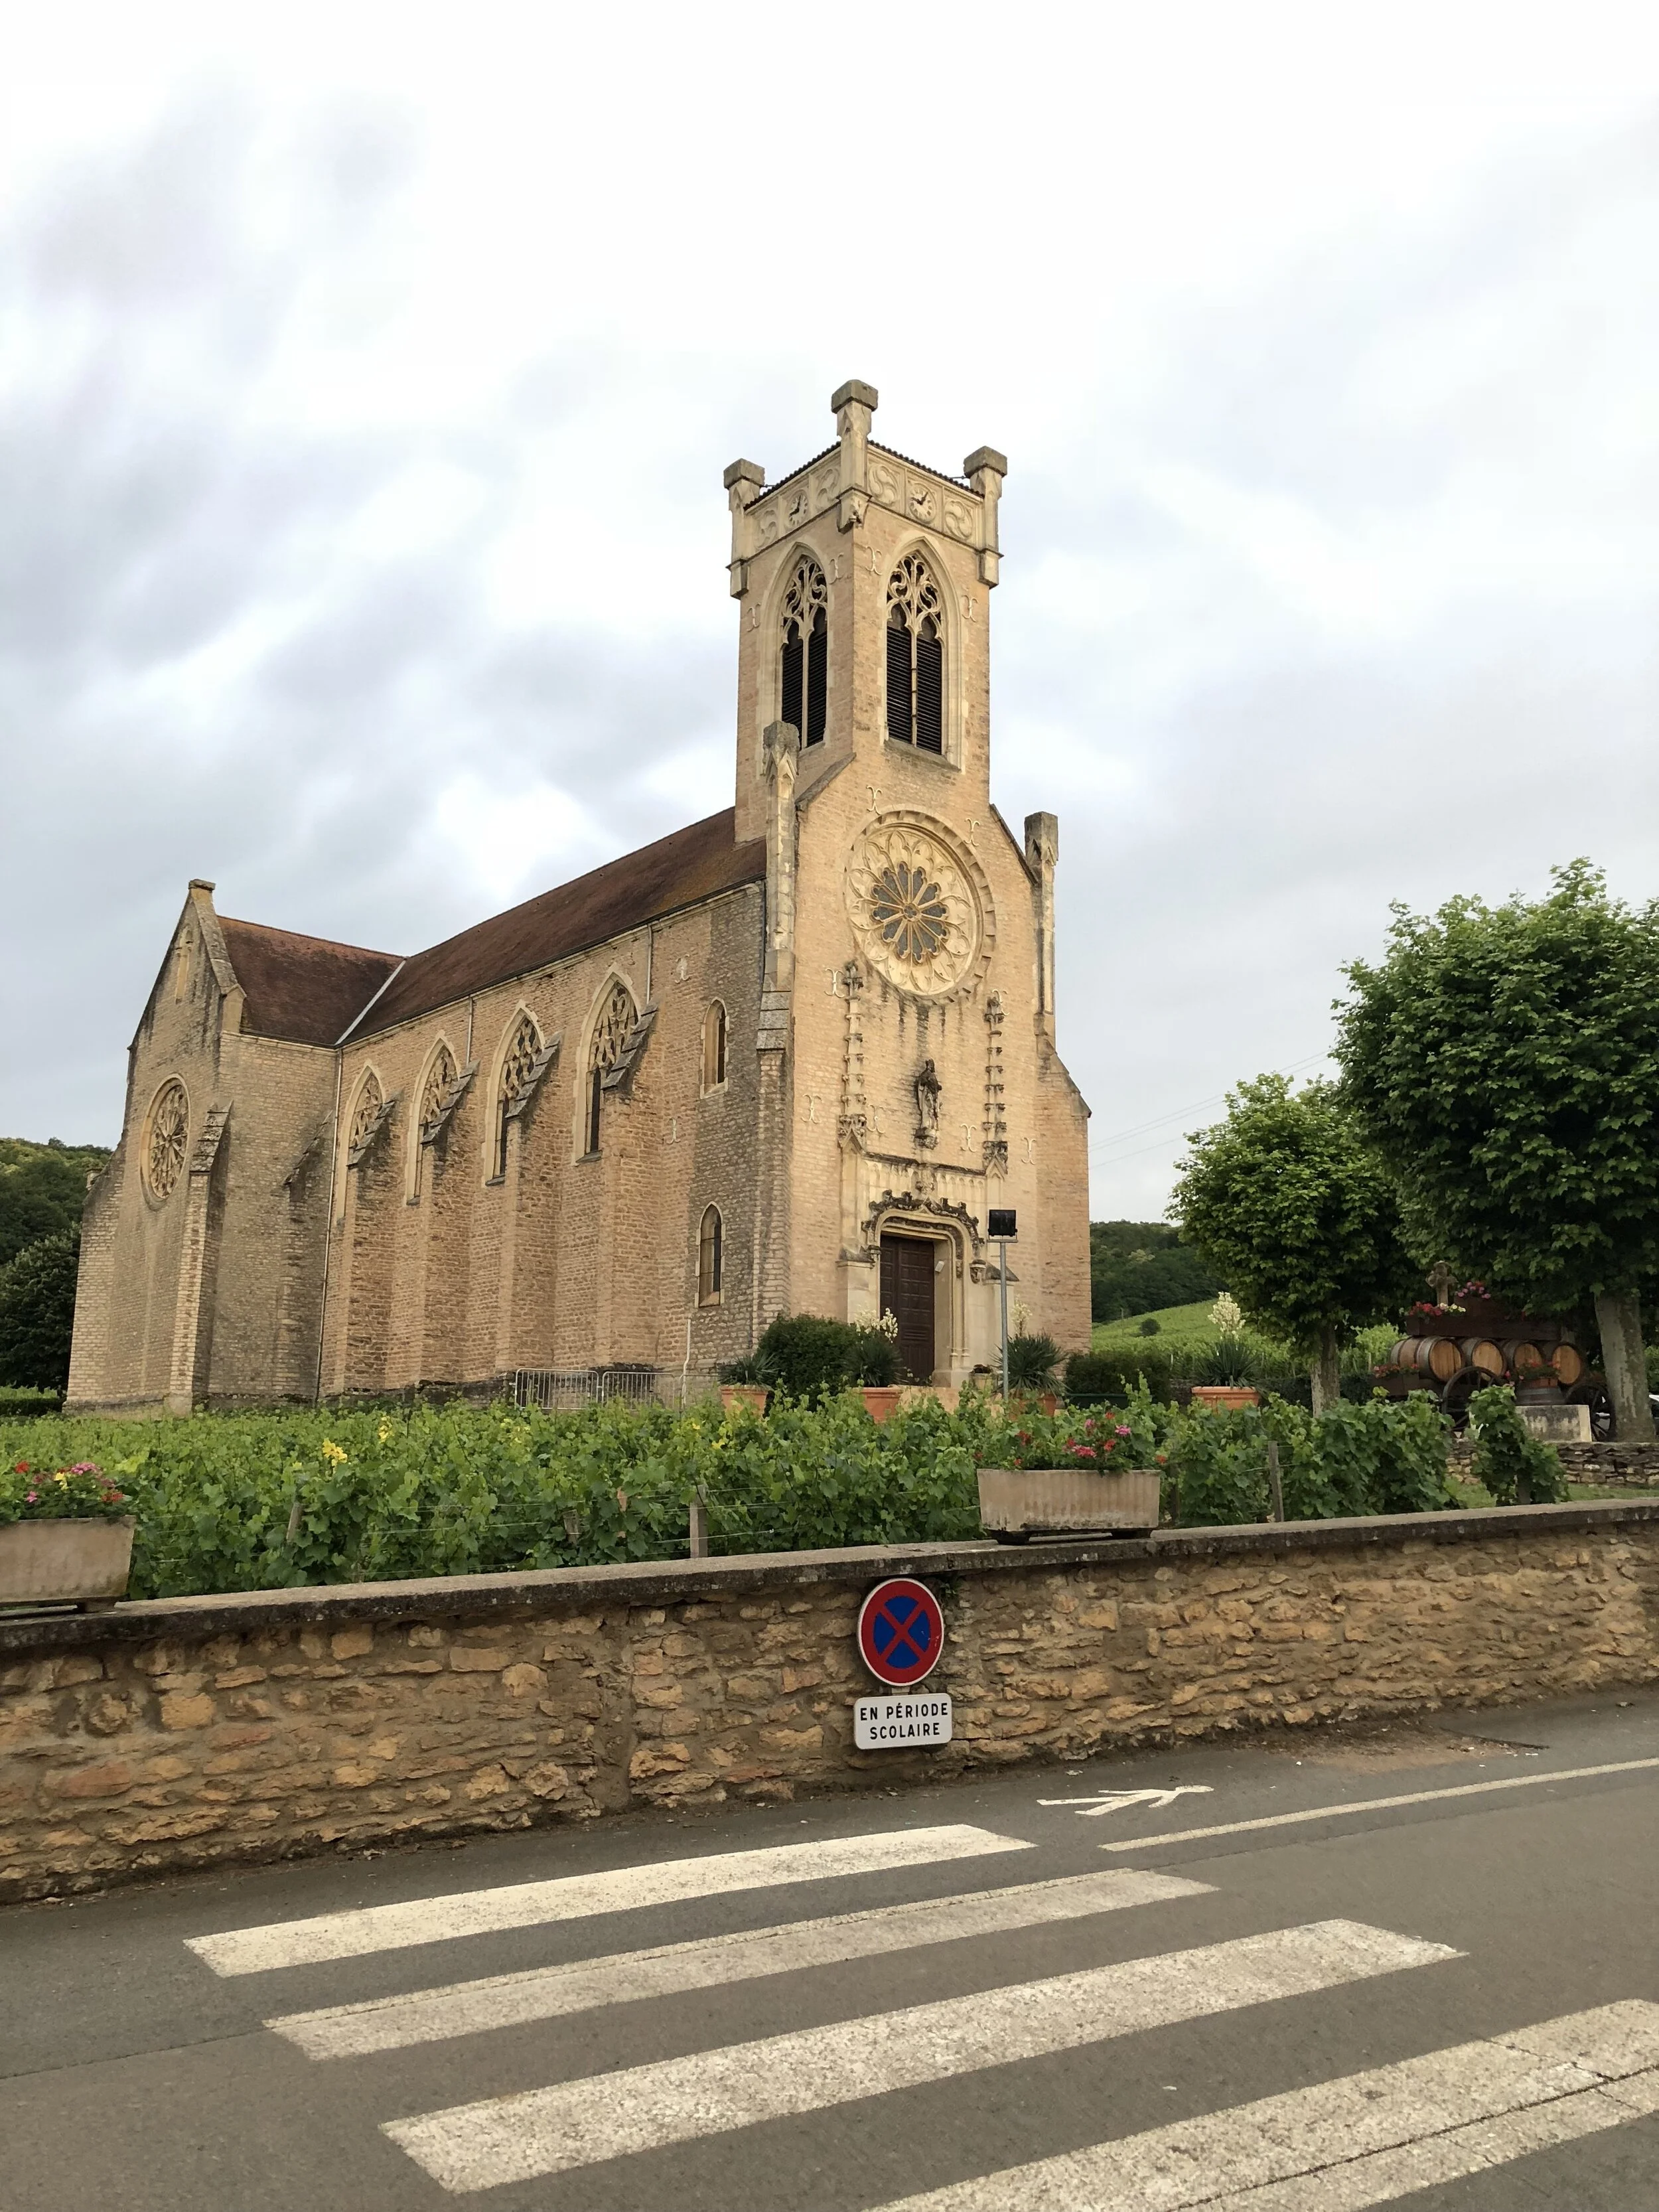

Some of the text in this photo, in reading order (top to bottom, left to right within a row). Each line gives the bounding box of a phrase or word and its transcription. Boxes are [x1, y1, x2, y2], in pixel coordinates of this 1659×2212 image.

[860, 1702, 948, 1721] EN PÉRIODE
[870, 1722, 940, 1739] SCOLAIRE
